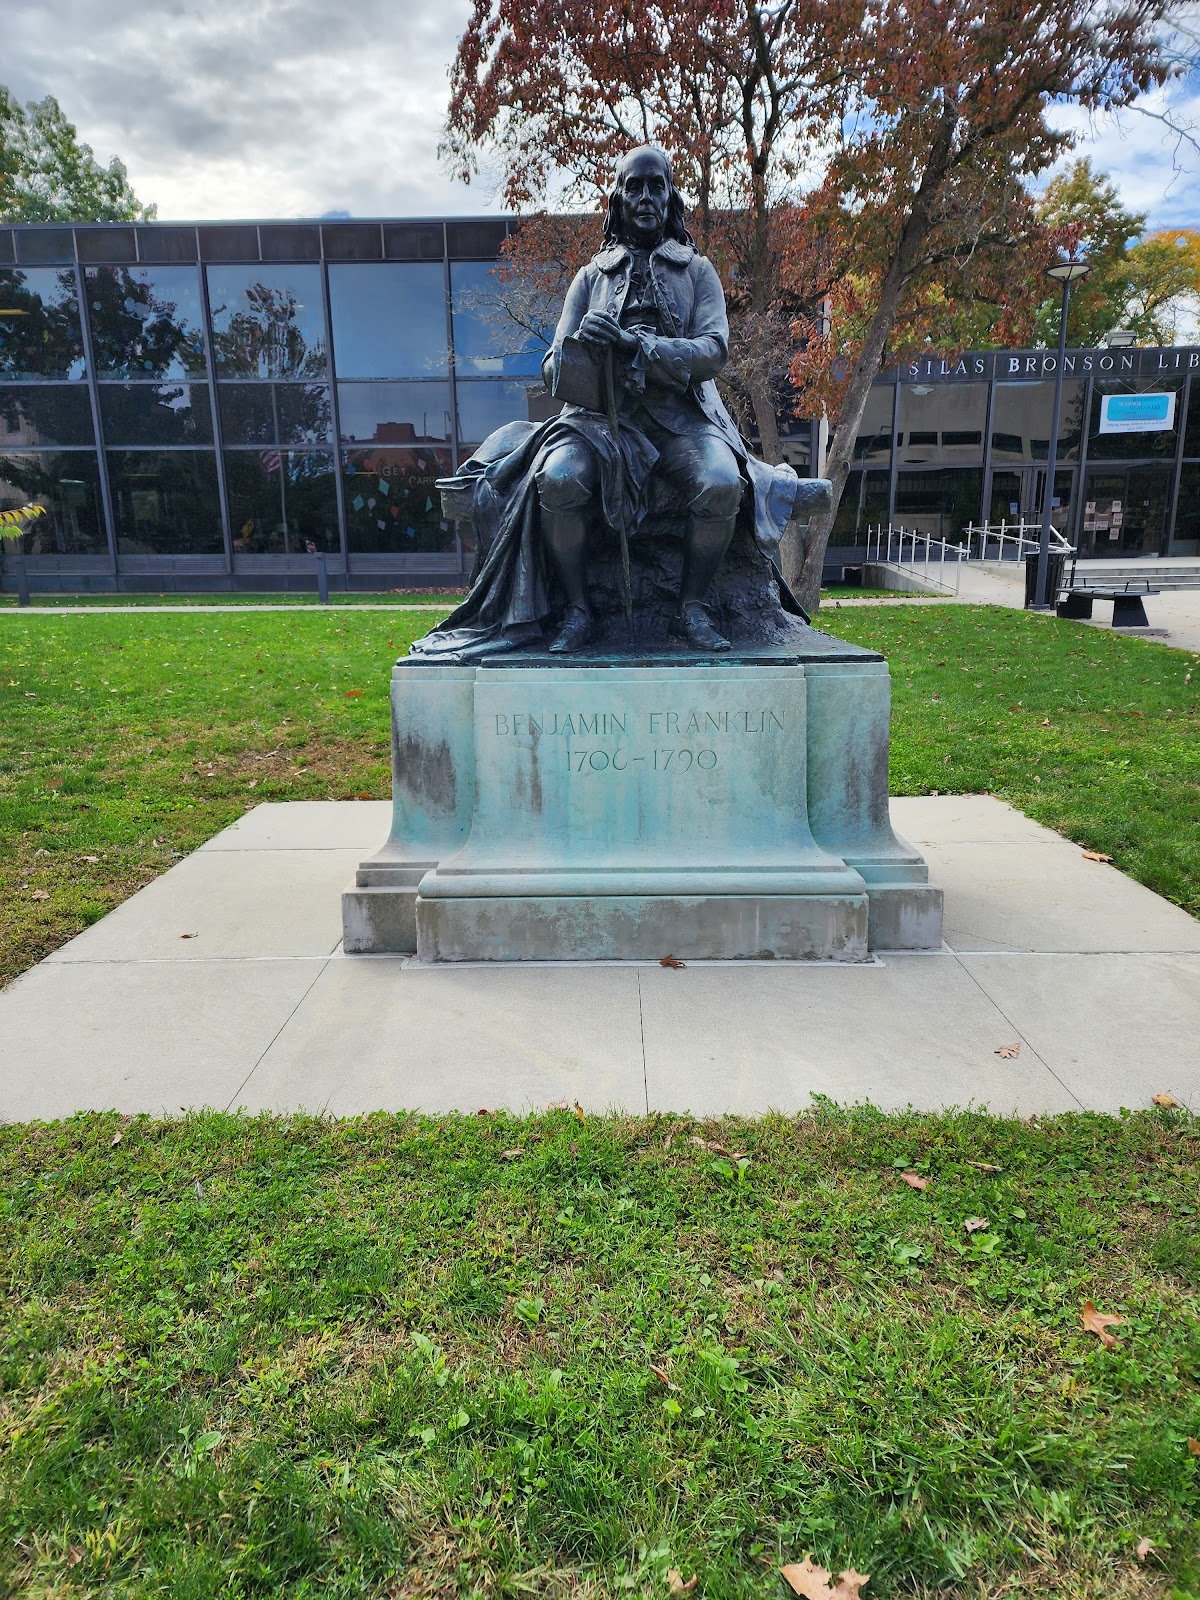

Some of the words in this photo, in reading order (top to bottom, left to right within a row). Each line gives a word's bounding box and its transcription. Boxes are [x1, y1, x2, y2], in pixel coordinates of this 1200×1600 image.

[909, 358, 985, 376] SILAS
[1008, 354, 1135, 373] BRONSON
[1158, 353, 1200, 369] LIB
[382, 466, 406, 477] GET
[495, 712, 627, 736] BENJAMIN
[648, 711, 786, 735] FRANKLIN
